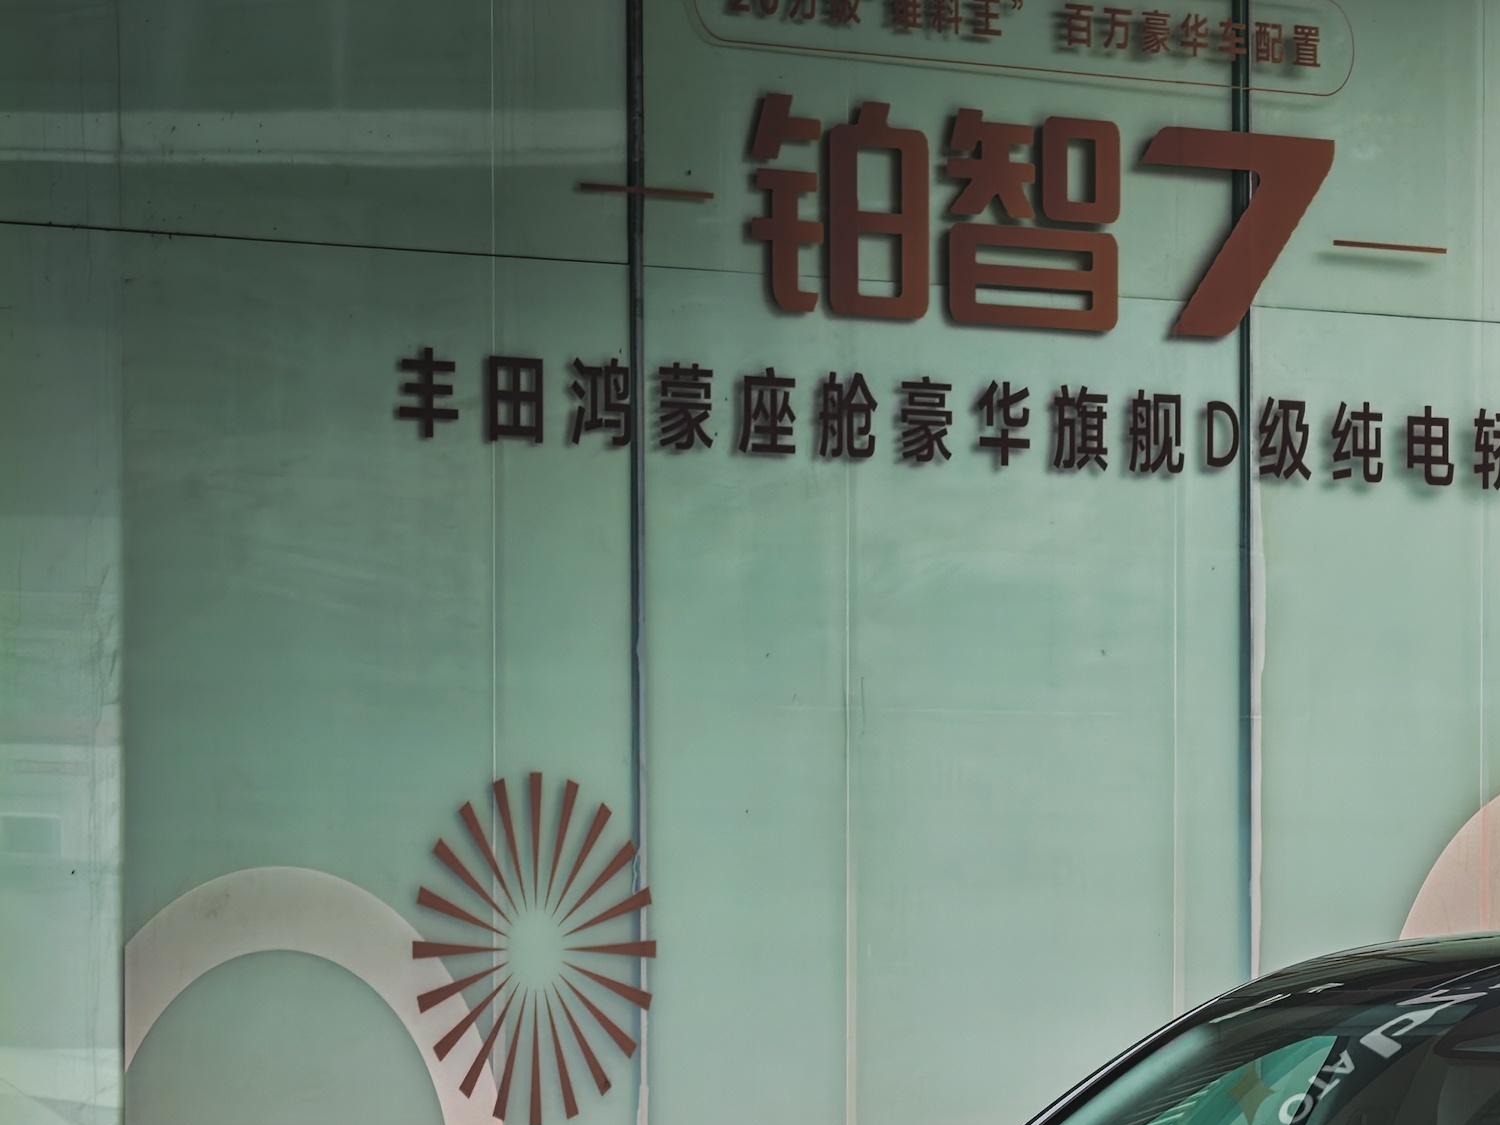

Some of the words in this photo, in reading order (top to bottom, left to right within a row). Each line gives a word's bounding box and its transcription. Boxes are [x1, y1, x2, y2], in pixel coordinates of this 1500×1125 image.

[1064, 3, 1321, 67] 百万豪华车配置
[750, 93, 1335, 337] 铂智7
